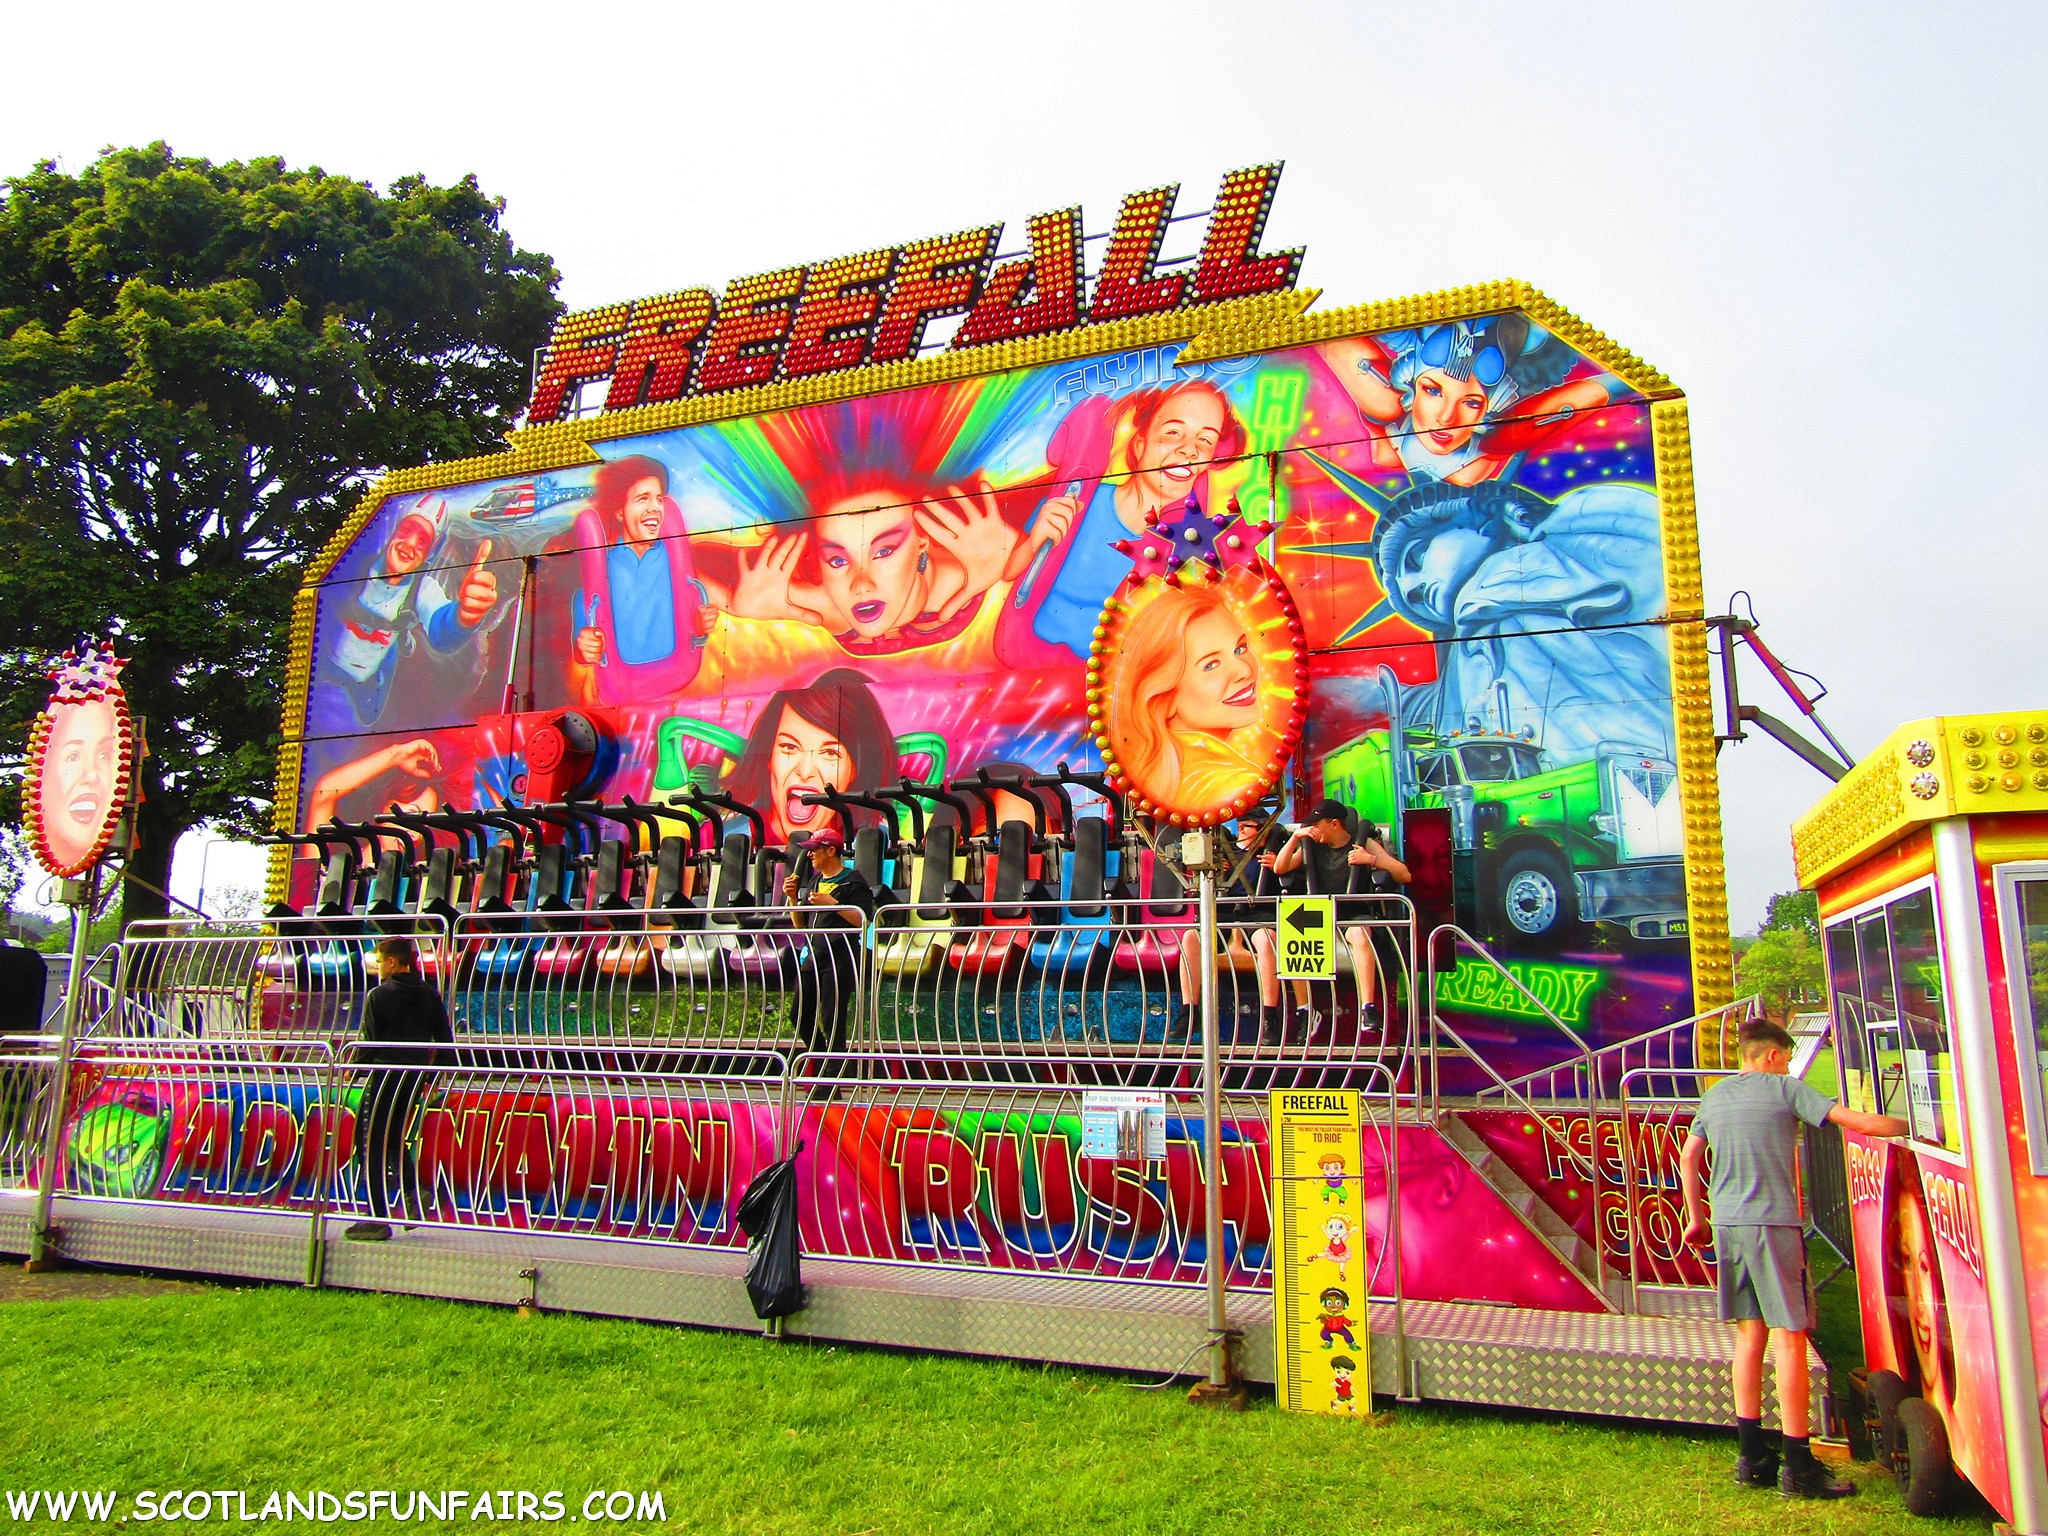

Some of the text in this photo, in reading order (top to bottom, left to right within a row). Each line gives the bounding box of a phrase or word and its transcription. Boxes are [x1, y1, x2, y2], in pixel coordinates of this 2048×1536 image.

[526, 158, 1307, 428] FREEFALL
[1285, 957, 1326, 973] WAY
[1286, 939, 1325, 956] ONE
[1435, 961, 1598, 1021] READY
[1282, 1095, 1349, 1111] FREEFALL
[1313, 1132, 1342, 1143] TO RIDE
[163, 1098, 1272, 1273] ADRNALIN RUSH
[1847, 1141, 1882, 1206] FREE
[1924, 1170, 1981, 1280] FALL
